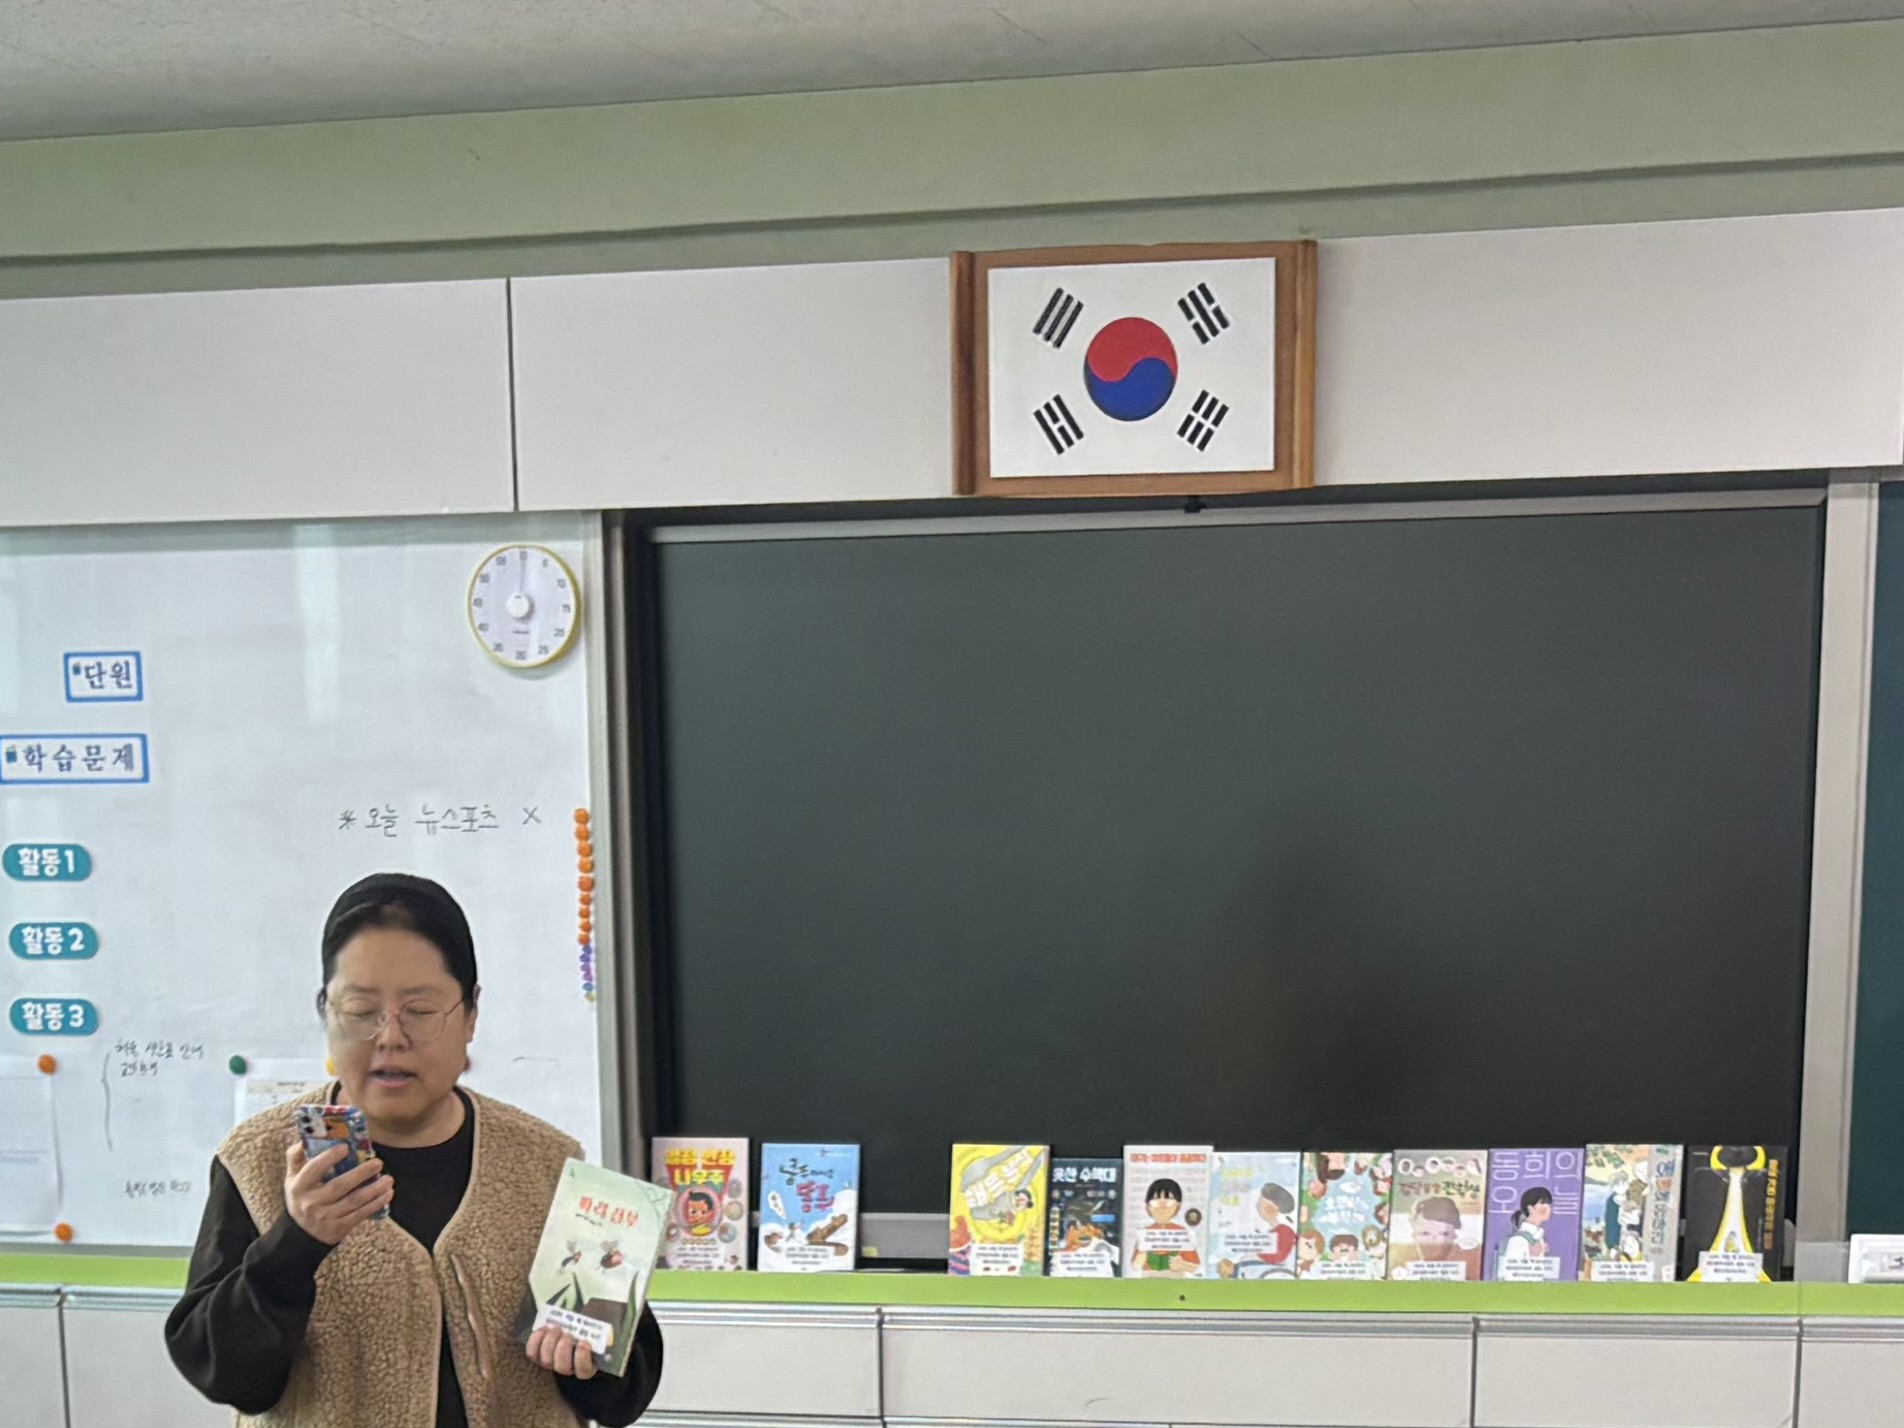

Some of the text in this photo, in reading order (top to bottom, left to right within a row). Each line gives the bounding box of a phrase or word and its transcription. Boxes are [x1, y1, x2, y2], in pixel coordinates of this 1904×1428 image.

[83, 659, 133, 690] 단원
[22, 742, 135, 773] 학습문제
[364, 803, 400, 838] 오늘
[414, 803, 499, 837] 뉴스포츠
